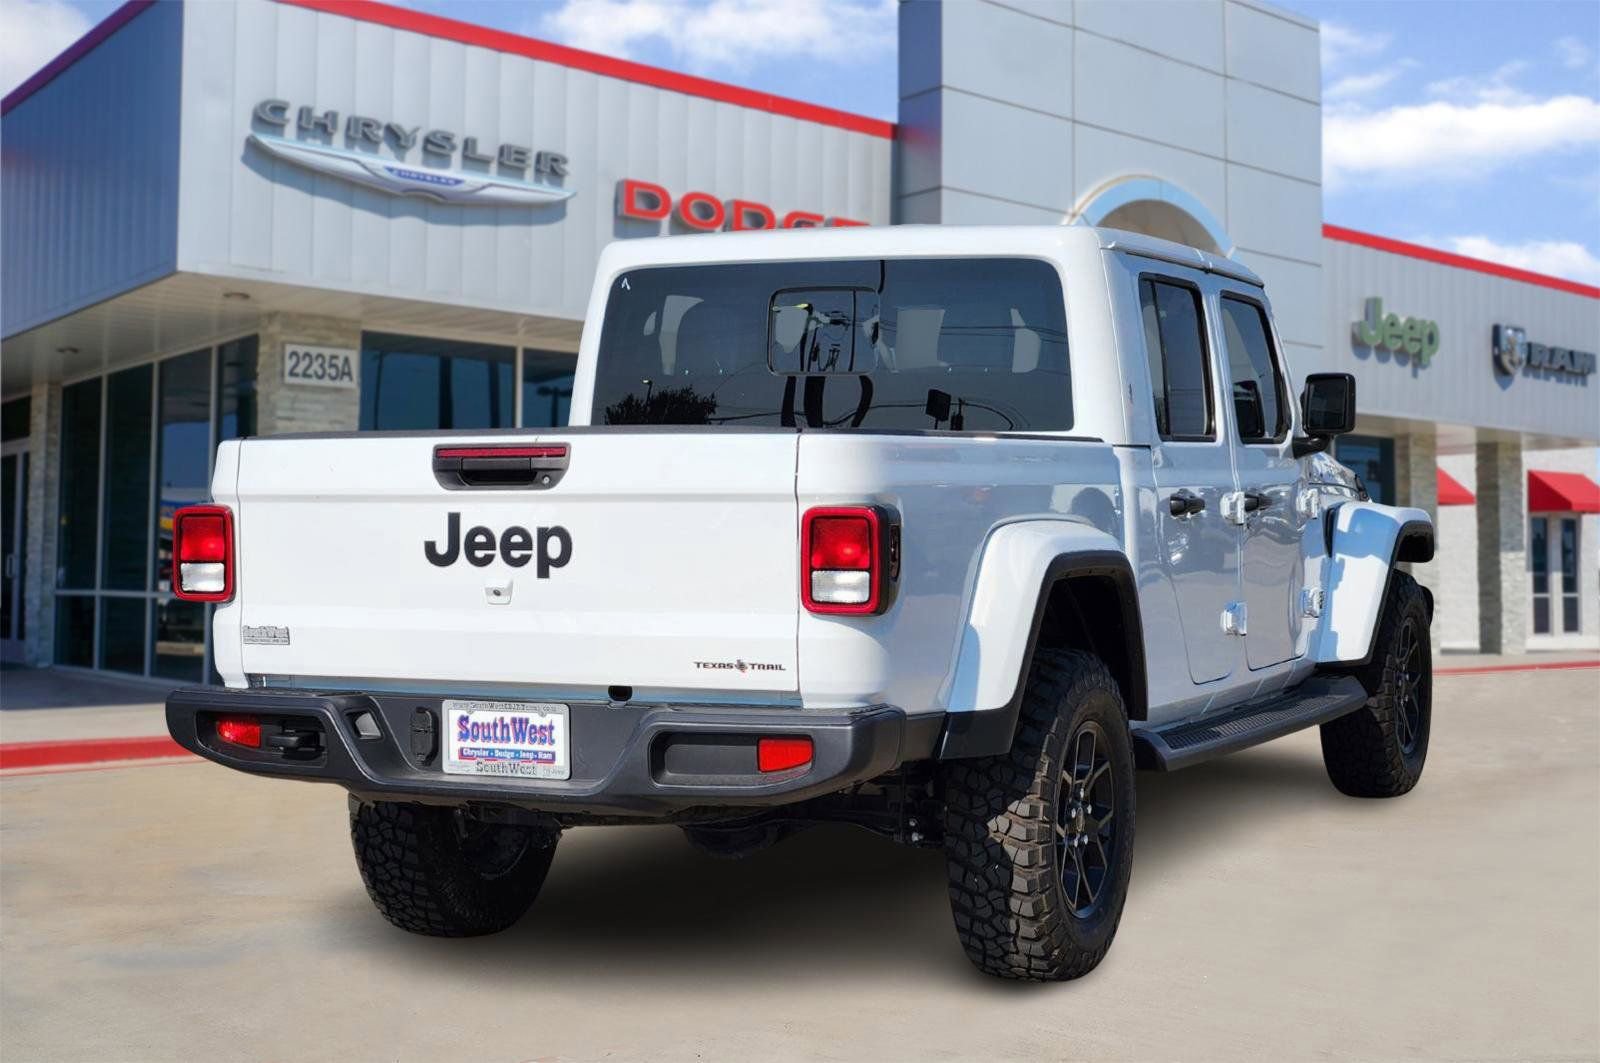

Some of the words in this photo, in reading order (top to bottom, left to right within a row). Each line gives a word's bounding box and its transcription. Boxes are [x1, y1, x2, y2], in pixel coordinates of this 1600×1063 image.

[251, 98, 569, 176] CHRYSLER
[616, 178, 870, 232] DOD
[1352, 296, 1440, 366] Jeep
[288, 350, 353, 382] 2235A
[1525, 342, 1596, 376] RAM
[424, 512, 572, 579] Jeep
[693, 661, 734, 670] TEXAS
[749, 663, 786, 671] TRAIL
[457, 714, 556, 746] SouthWest
[476, 761, 536, 775] SouthWest
